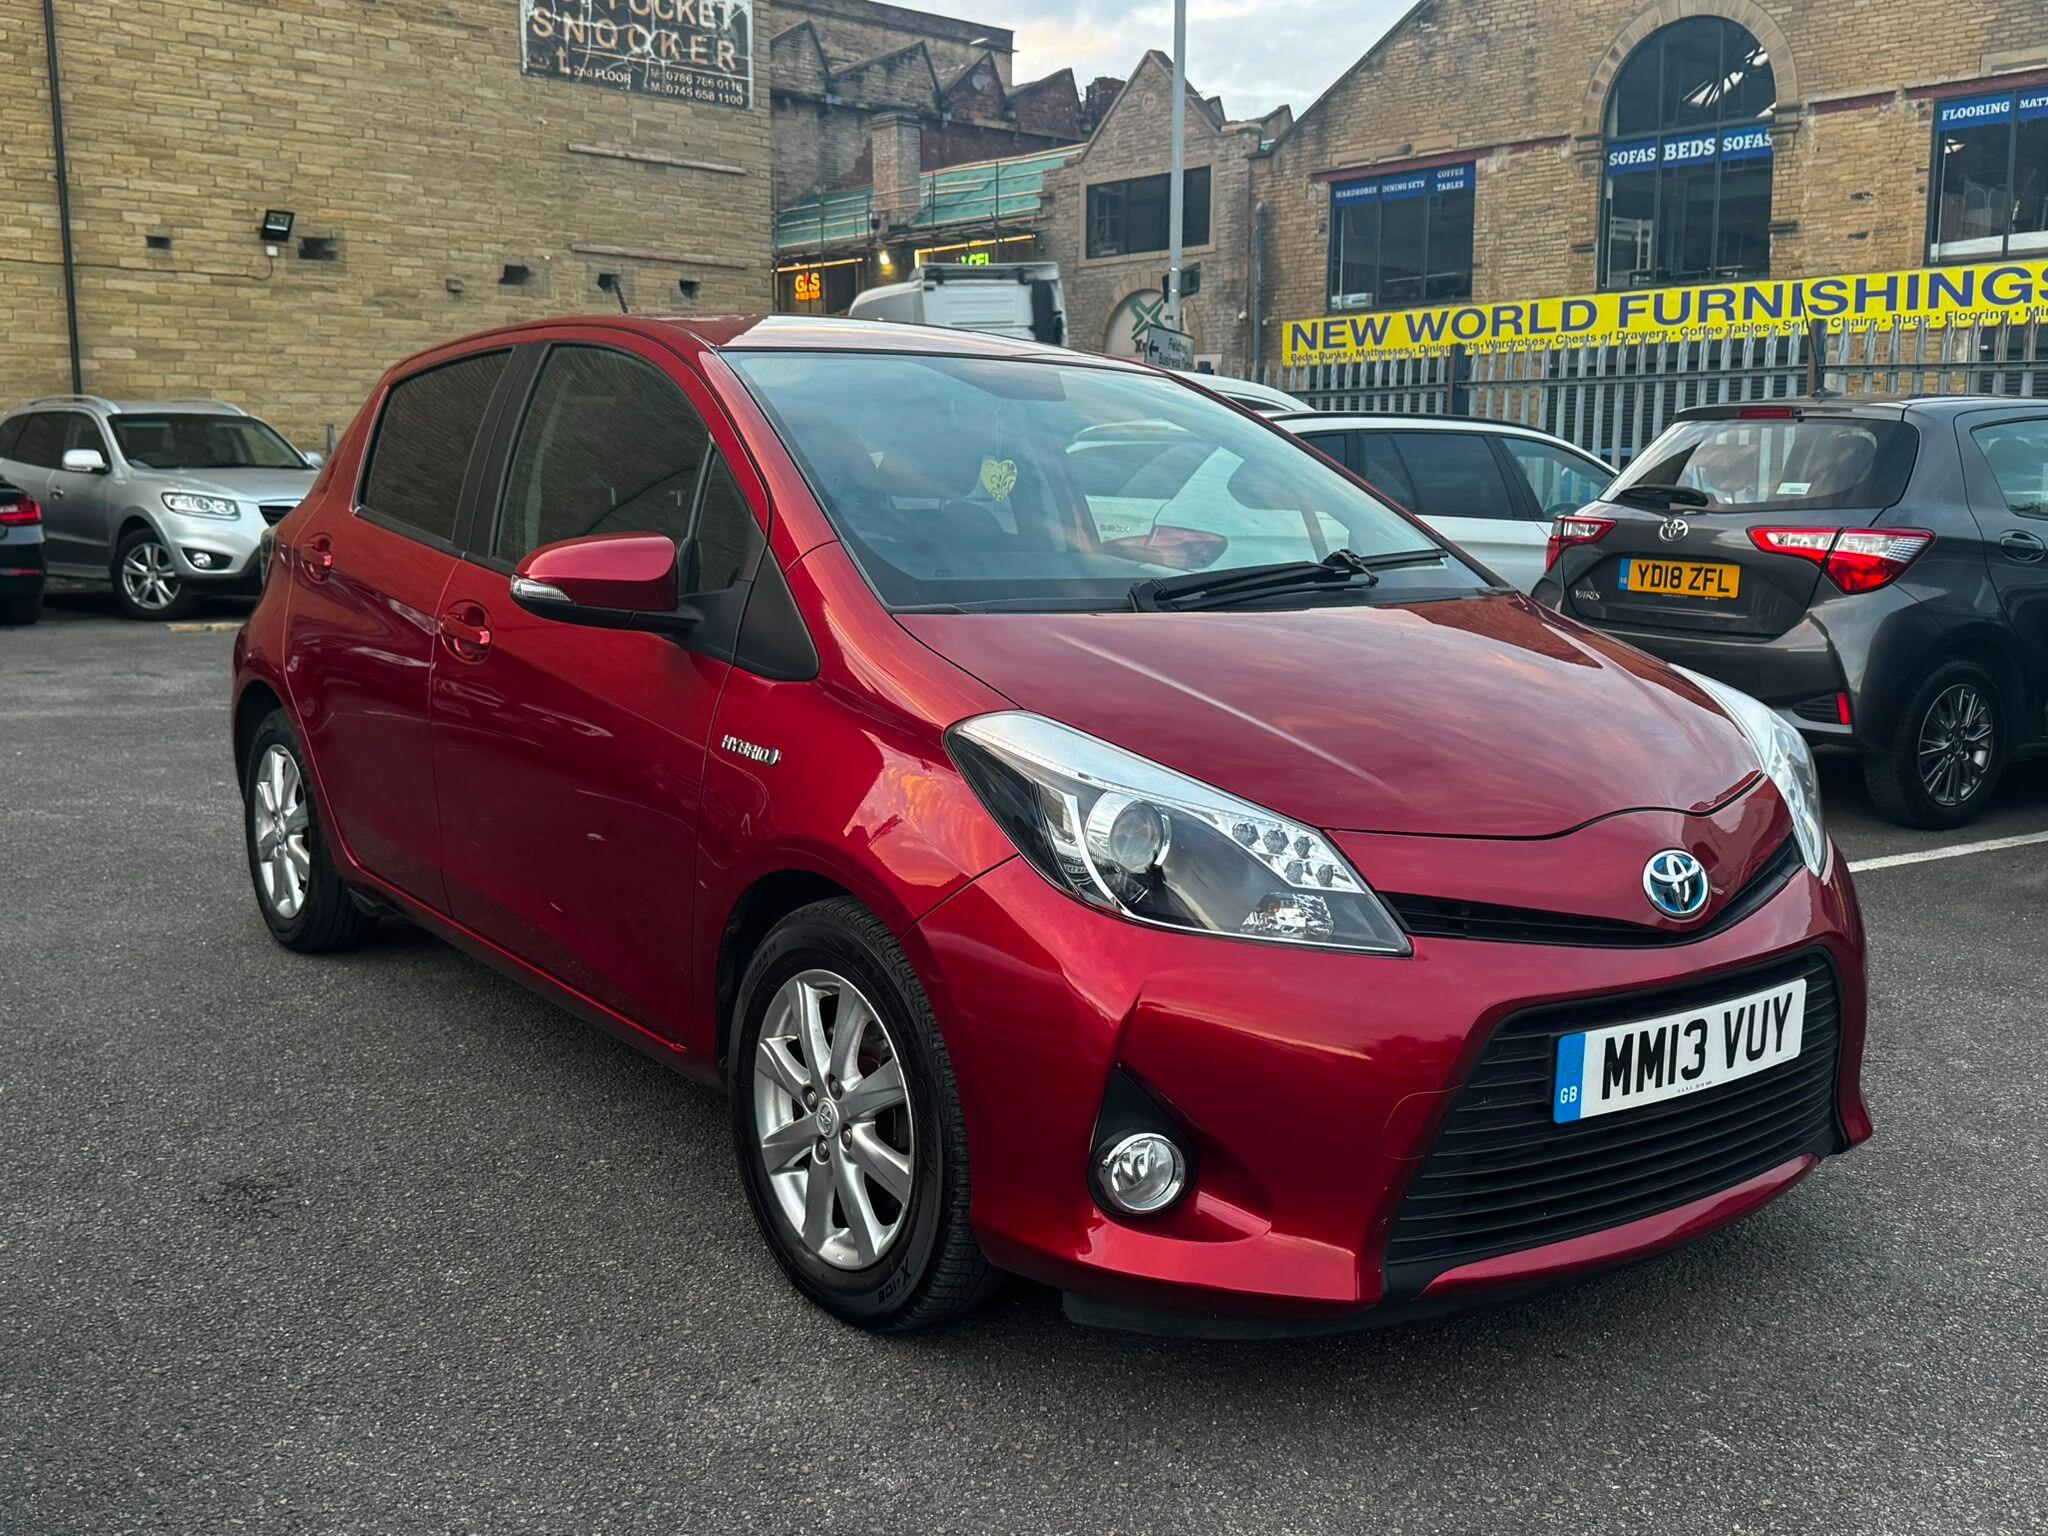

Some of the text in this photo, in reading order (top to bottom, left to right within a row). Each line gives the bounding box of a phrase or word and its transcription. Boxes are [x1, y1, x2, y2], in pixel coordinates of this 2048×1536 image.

[533, 6, 737, 71] SNOOKER
[574, 64, 632, 86] 2nd FLOOR
[666, 84, 693, 97] 0745
[695, 89, 716, 101] 658
[718, 93, 744, 105] 1100
[1942, 101, 2010, 121] FLOORING
[1609, 133, 1773, 166] SOFAS BEDS SOFAS
[1437, 167, 1465, 179] COFFEE
[1335, 179, 1425, 198] WARDROBES DINING SETS
[1437, 180, 1465, 192] TABLES
[1291, 266, 2048, 351] NEW WORLD FURNISHING
[1291, 352, 1313, 362] Beds
[1318, 350, 1347, 361] Bunks
[1356, 346, 1410, 358] Mattresses
[1556, 333, 1597, 344] Chests
[1601, 331, 1613, 341] of
[1616, 330, 1668, 341] Drawers
[1680, 325, 1723, 336] Coffee
[1728, 321, 1770, 333] Tables
[1892, 313, 1930, 326] Rugs
[1945, 308, 2010, 322] Flooring
[1638, 563, 1683, 589] YD18
[1688, 567, 1730, 593] ZFL
[1575, 589, 1601, 601] YARIS
[721, 734, 770, 763] HYBRID
[1560, 992, 1793, 1105] GB MM13 VUY
